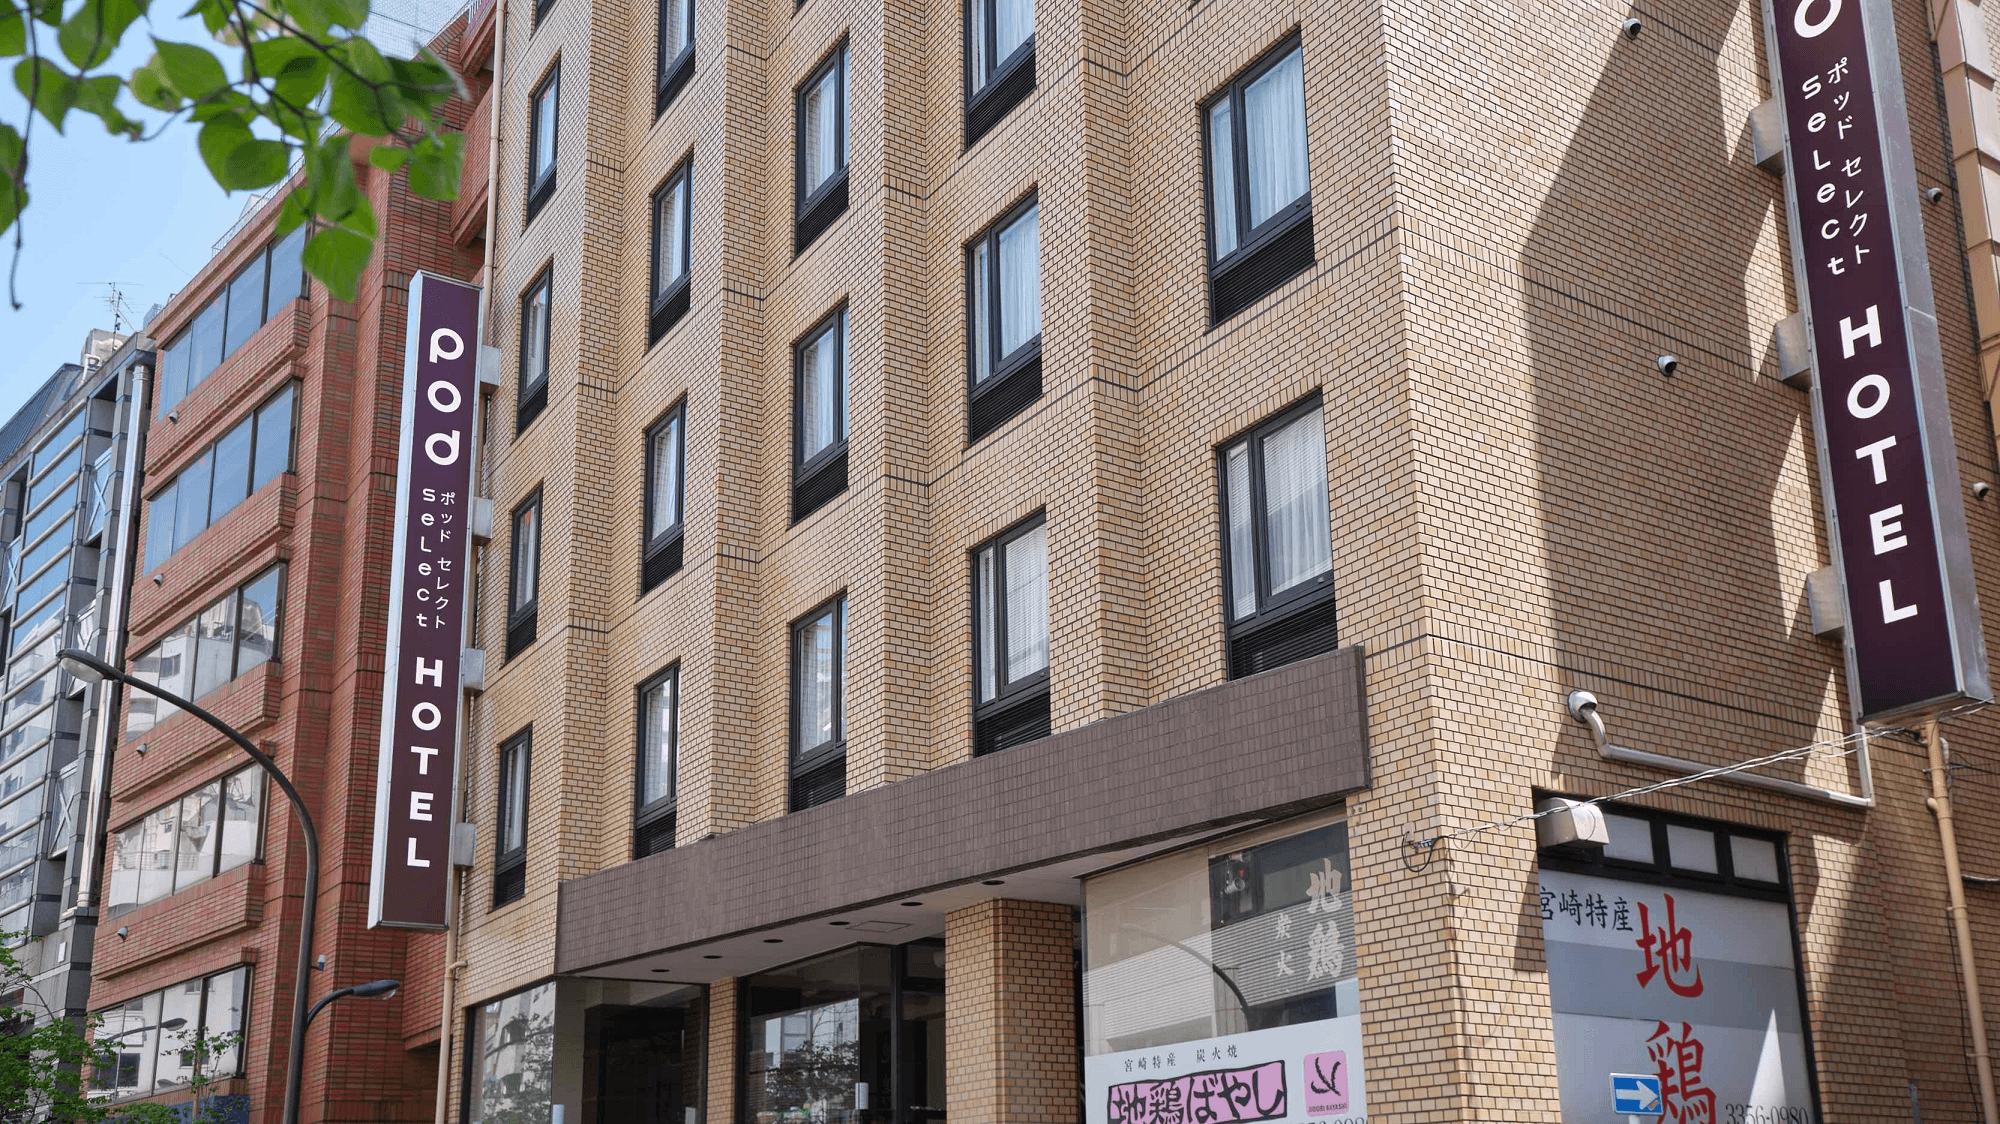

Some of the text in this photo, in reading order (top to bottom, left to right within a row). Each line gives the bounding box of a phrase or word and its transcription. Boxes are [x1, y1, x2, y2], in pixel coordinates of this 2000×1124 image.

[1827, 56, 1870, 265] ポッド セレクト
[424, 327, 465, 466] pod
[1839, 304, 1918, 624] HOTEL
[435, 491, 456, 629] ポッド セレクト
[407, 656, 444, 868] HOTEL
[1540, 886, 1634, 932] 宮崎特産
[1124, 1044, 1239, 1073] 宮崎特産 炭火焼
